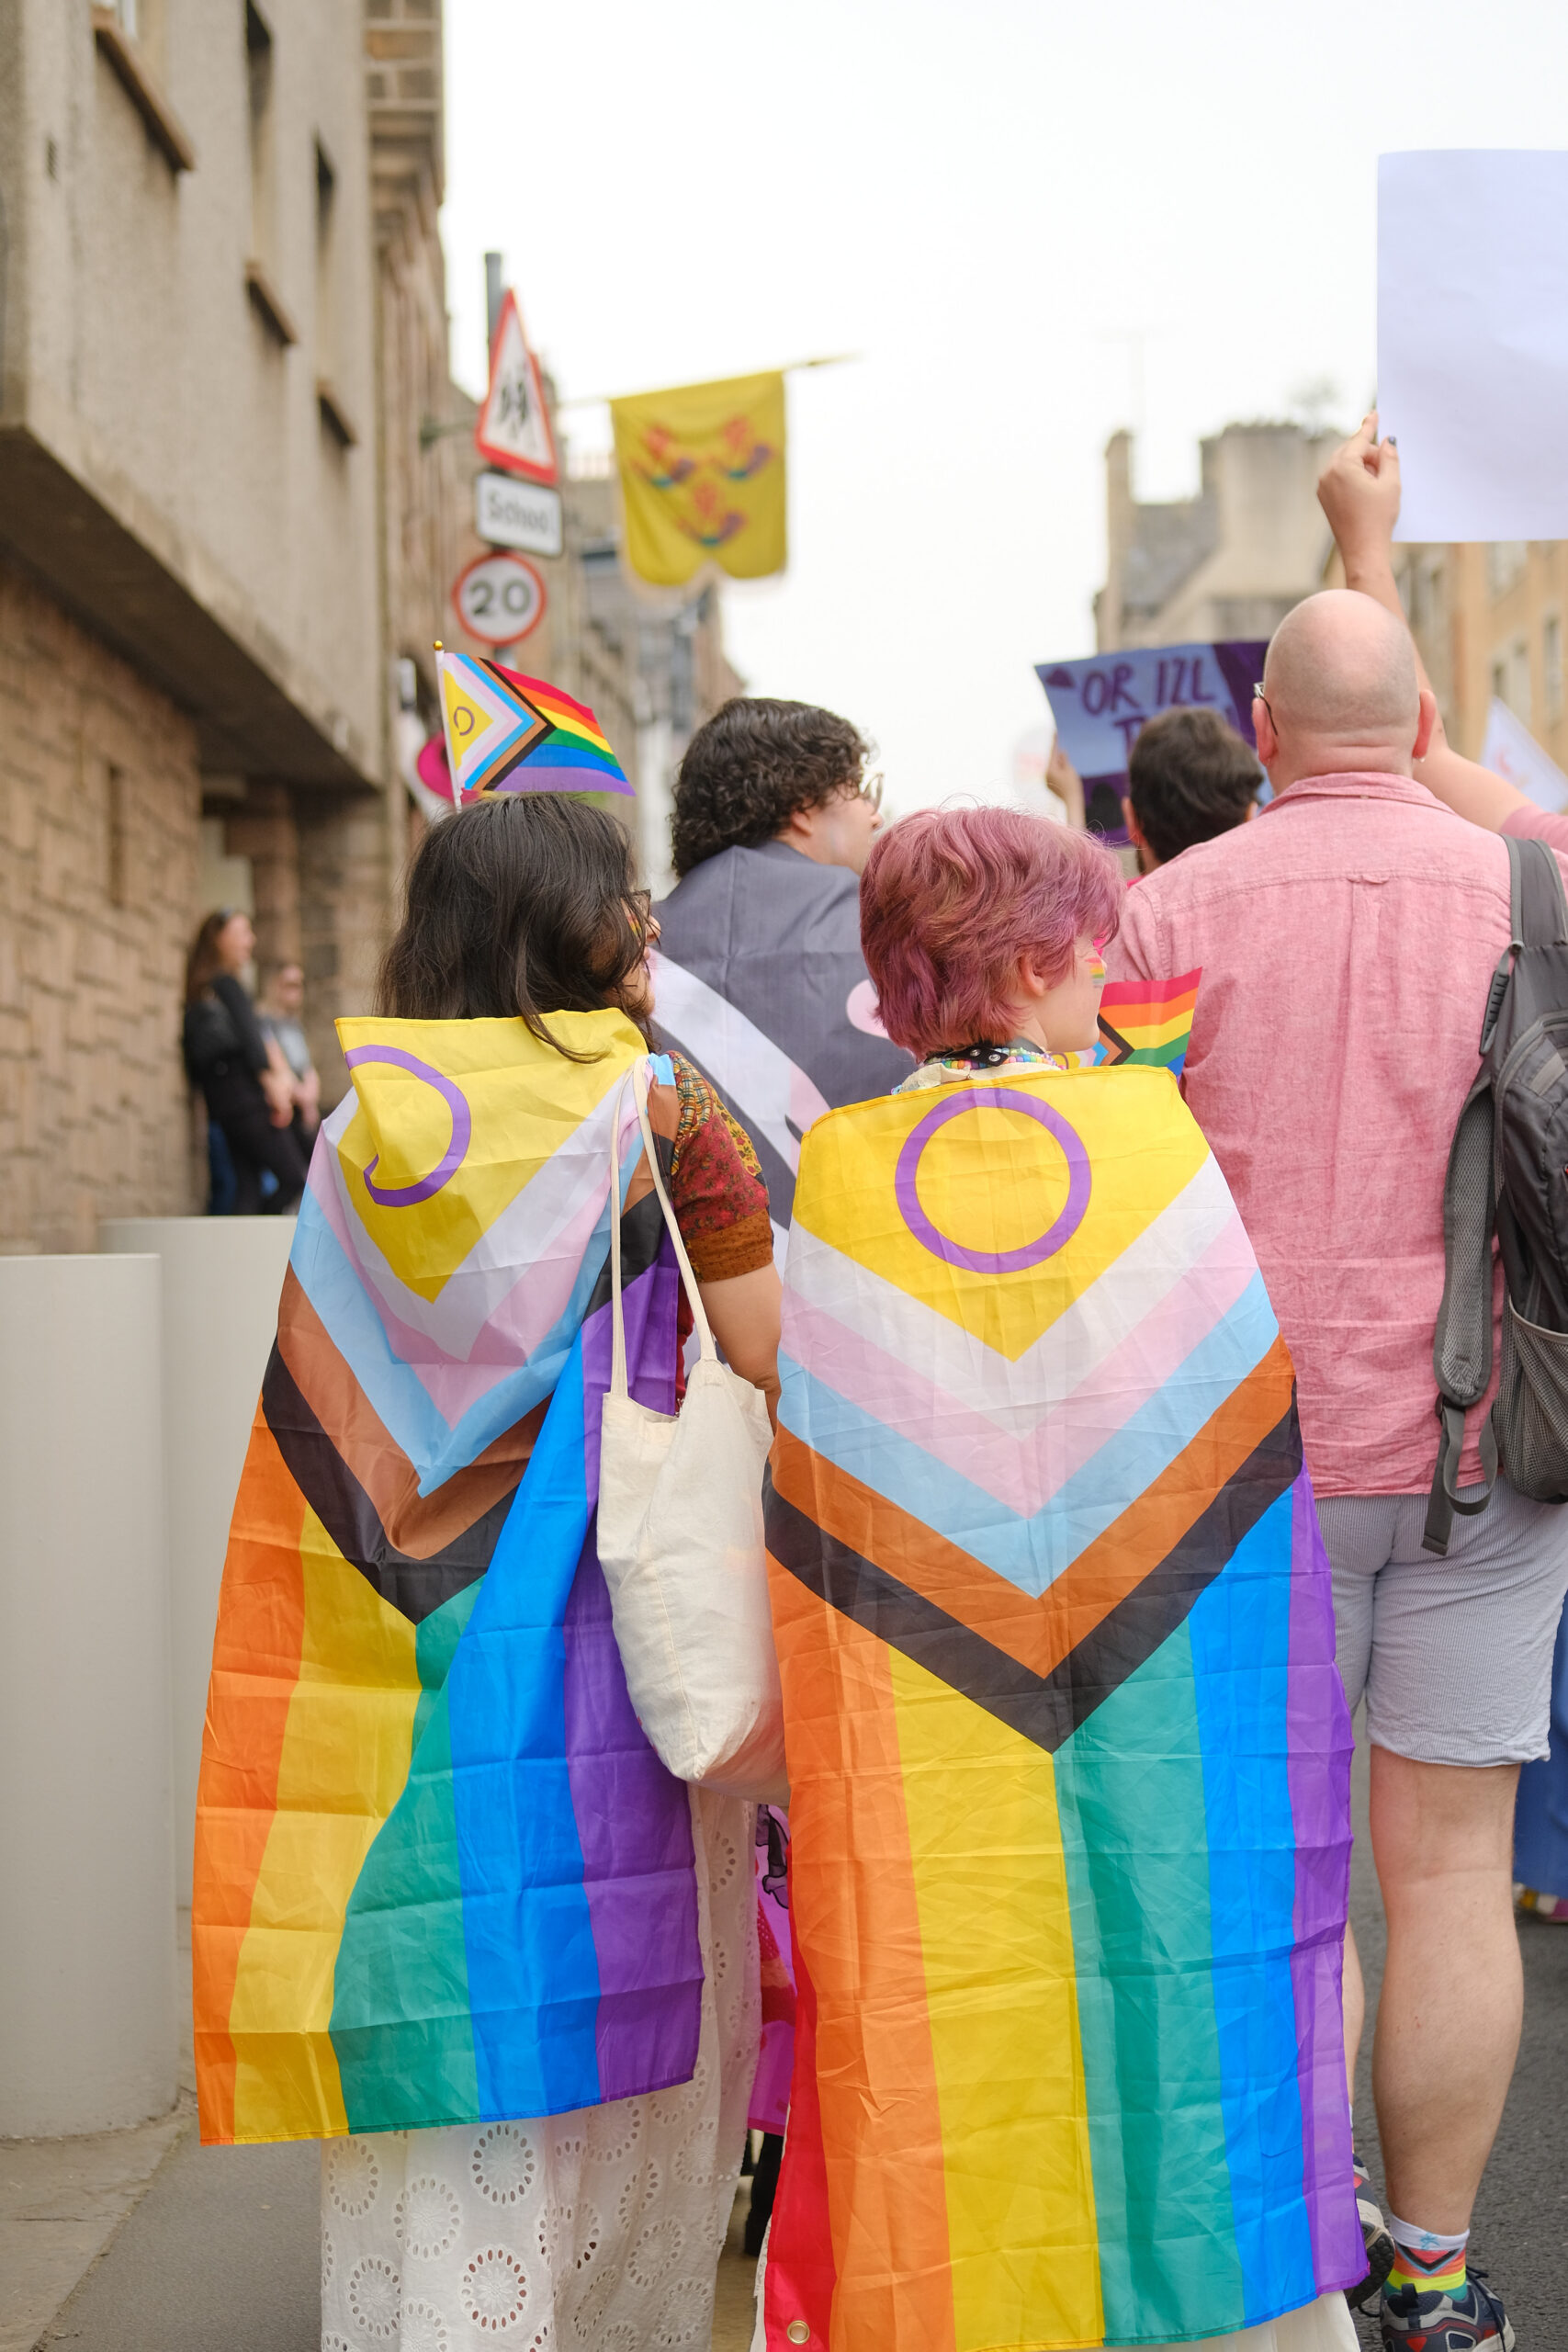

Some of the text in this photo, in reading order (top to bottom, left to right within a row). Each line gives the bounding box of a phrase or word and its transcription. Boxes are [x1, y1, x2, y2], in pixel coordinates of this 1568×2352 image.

[487, 490, 556, 537] School
[470, 580, 531, 616] 20
[1082, 662, 1141, 716] OR
